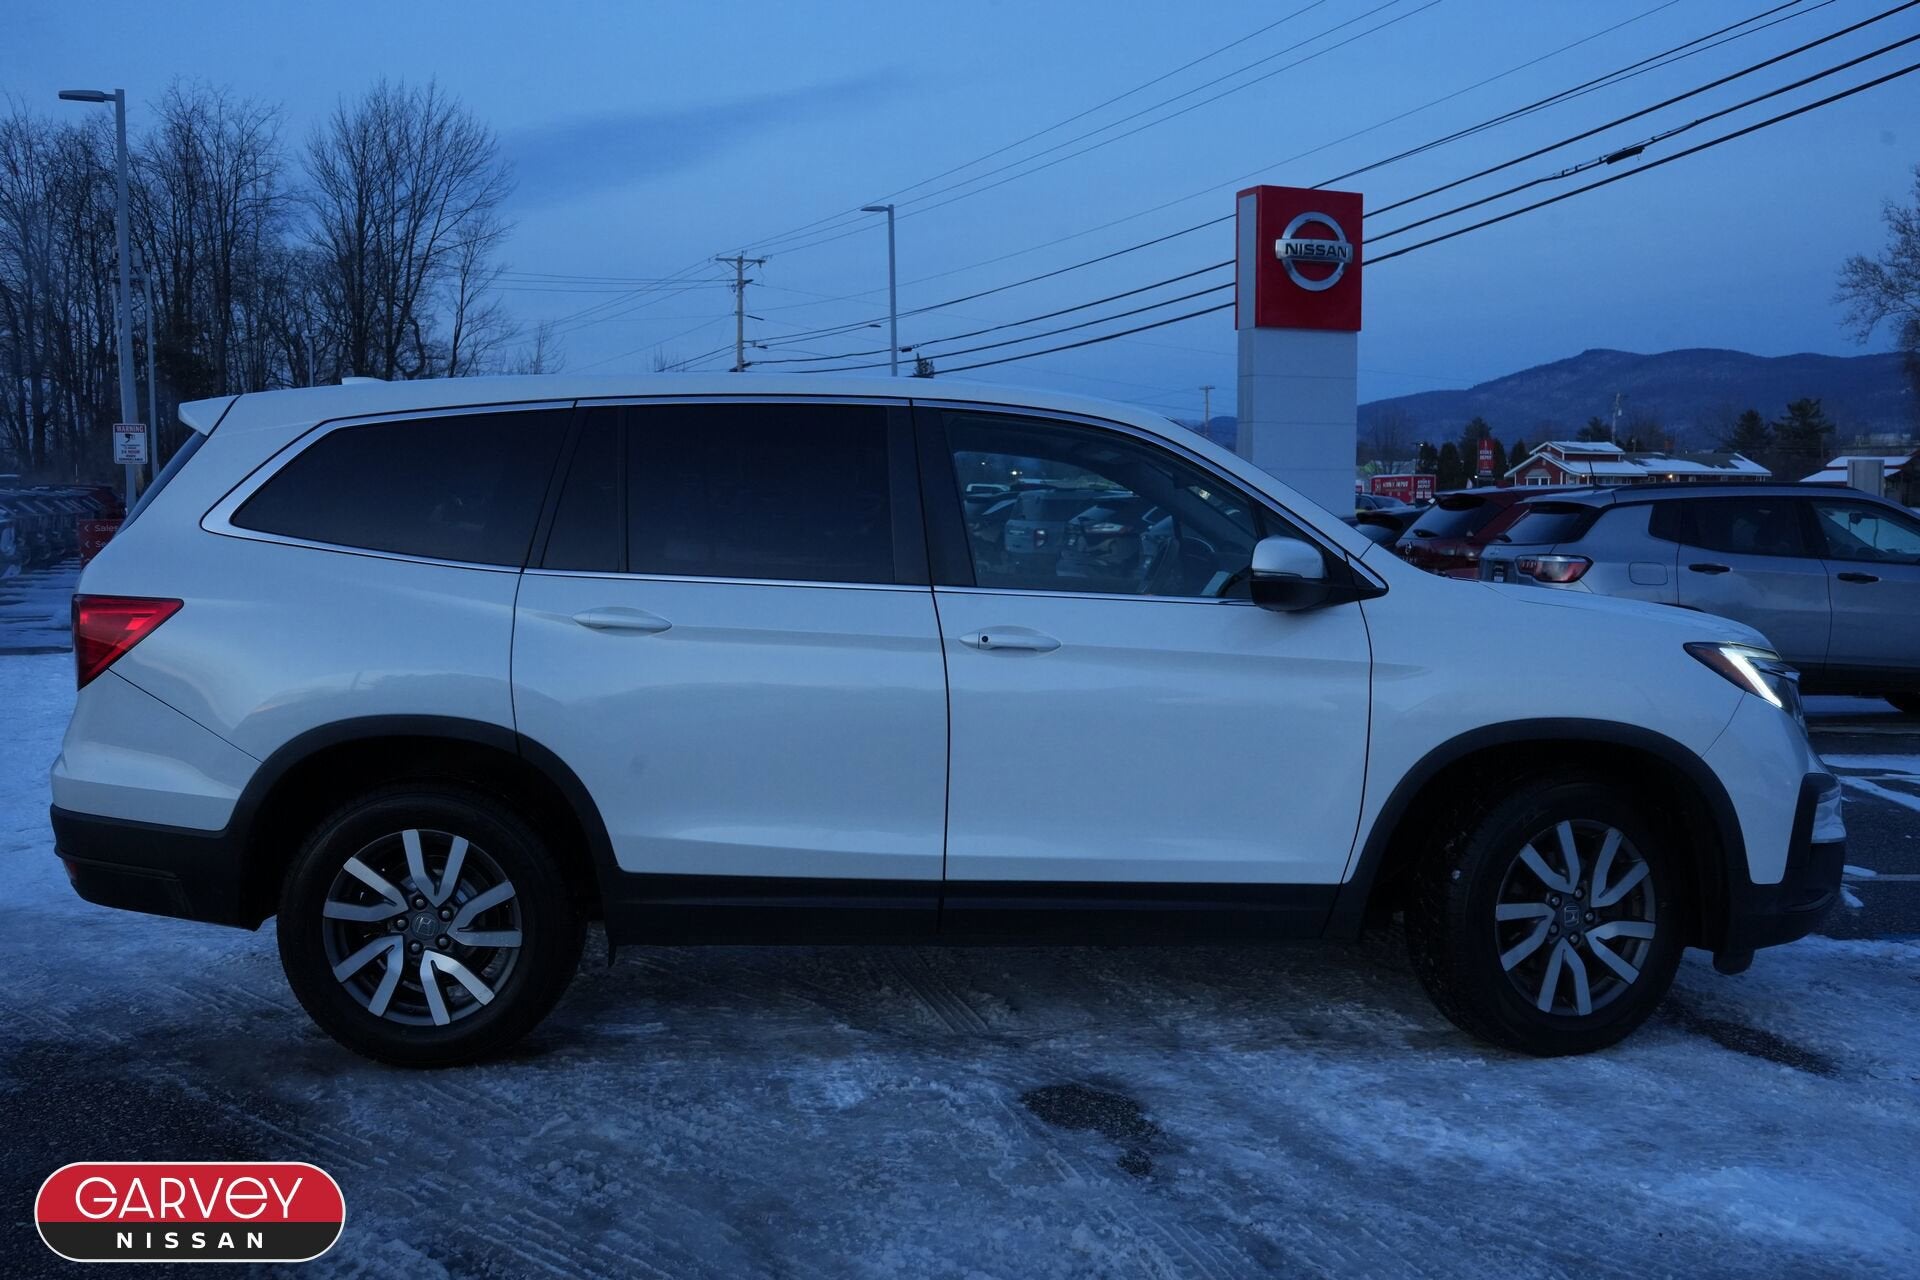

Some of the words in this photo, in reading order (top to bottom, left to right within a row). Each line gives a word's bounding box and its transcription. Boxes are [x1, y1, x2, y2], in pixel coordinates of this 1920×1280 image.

[1285, 243, 1347, 258] NISSAN
[115, 425, 144, 433] WARNING
[94, 524, 119, 532] Sales
